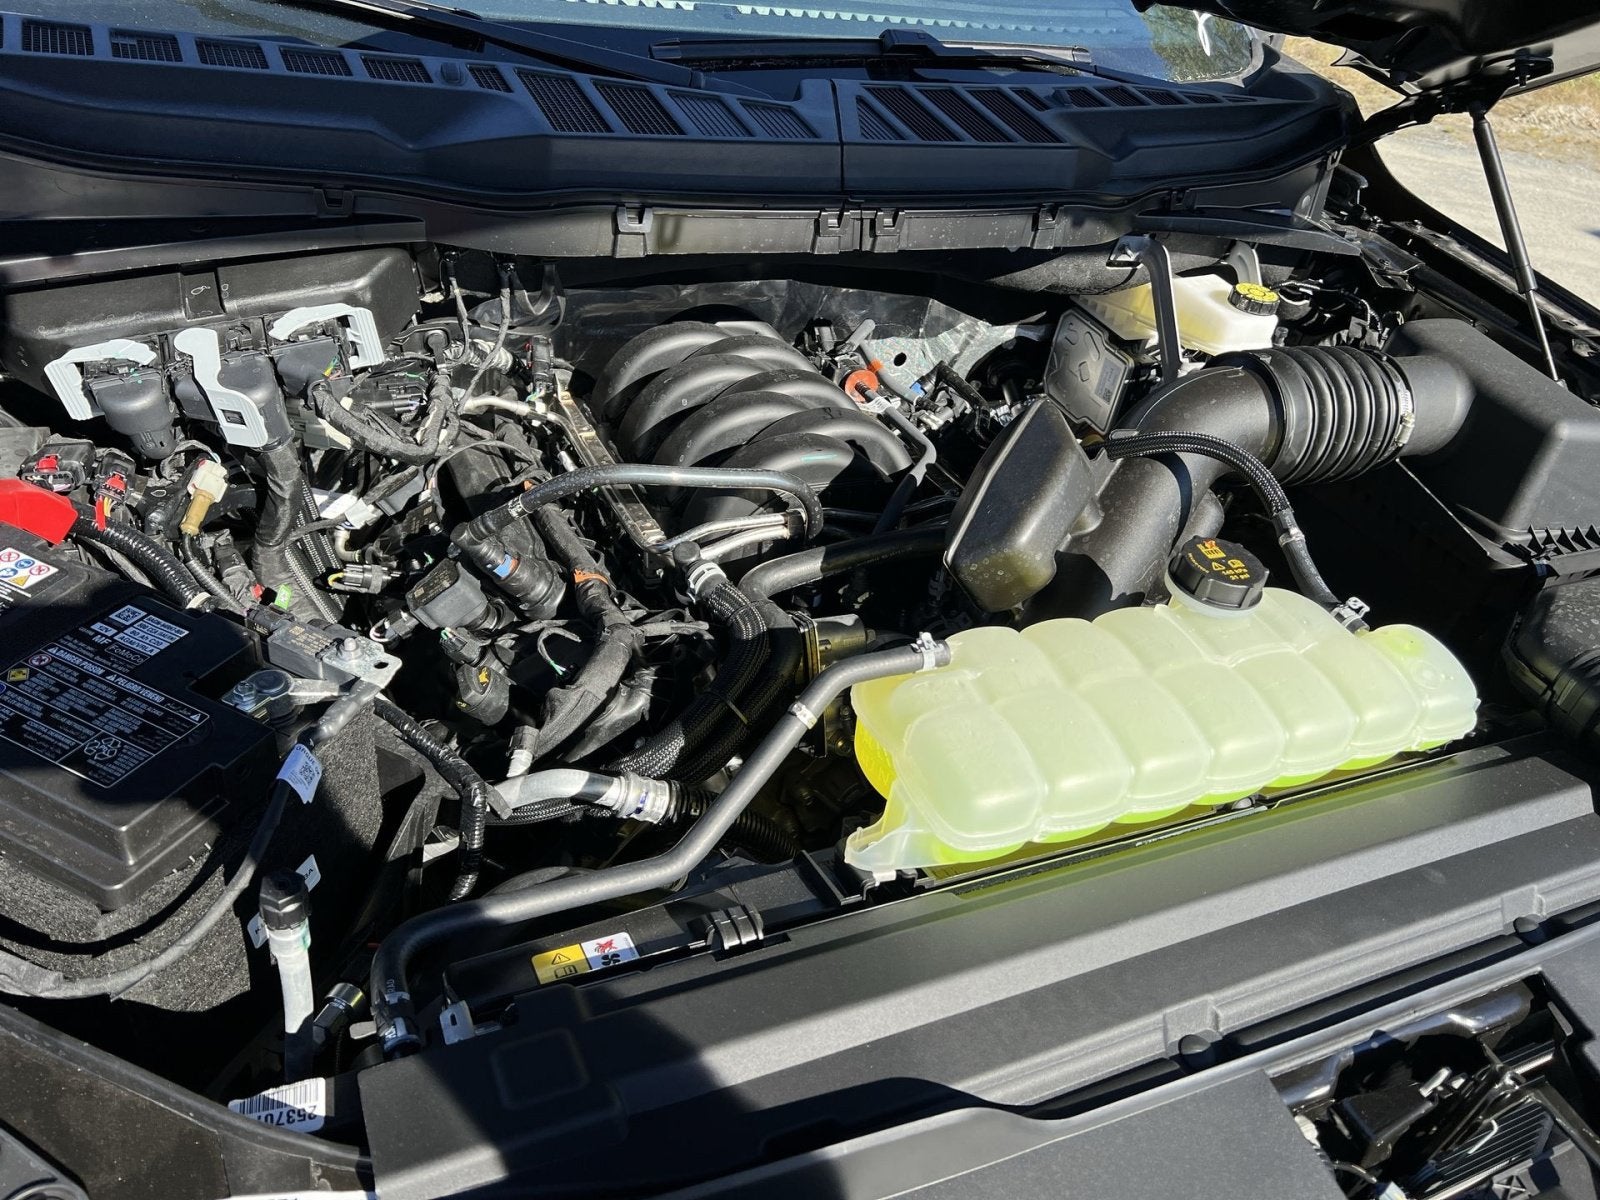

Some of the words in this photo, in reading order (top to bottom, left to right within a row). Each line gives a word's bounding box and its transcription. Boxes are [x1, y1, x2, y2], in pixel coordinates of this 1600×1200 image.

[98, 625, 112, 633] 12V
[92, 634, 113, 645] MF
[108, 645, 144, 663] FoMoCo
